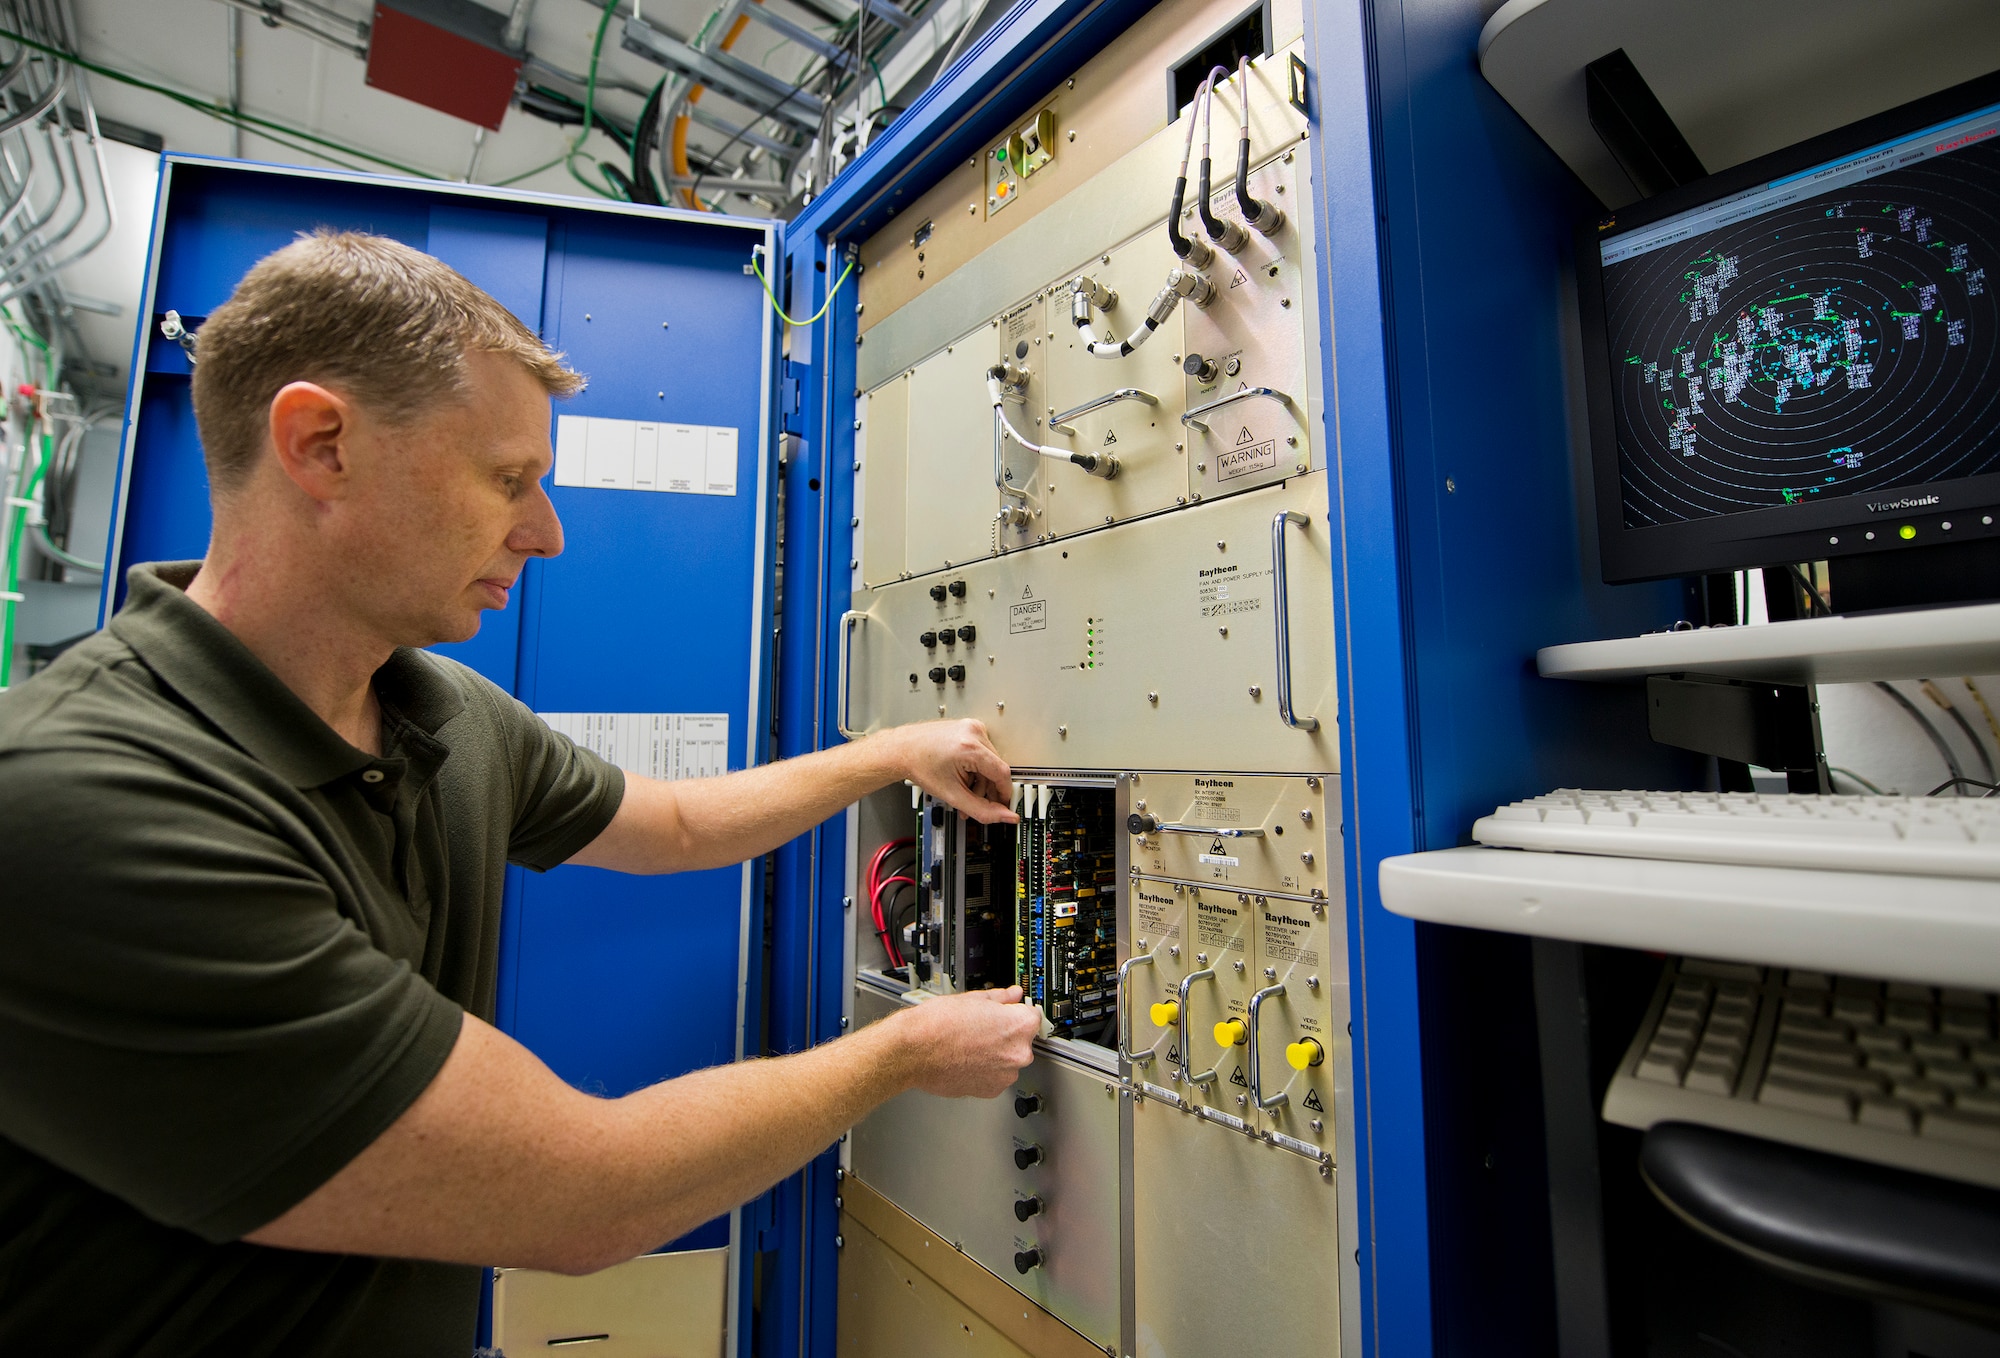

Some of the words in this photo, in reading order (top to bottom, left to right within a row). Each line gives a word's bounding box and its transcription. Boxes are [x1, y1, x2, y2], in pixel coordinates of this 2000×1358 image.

[1935, 128, 1997, 153] Raytheon
[1814, 170, 1834, 179] Radar
[1835, 164, 1852, 172] Data
[1853, 154, 1880, 166] Display
[1260, 256, 1287, 272] SENSITIVITY
[1008, 303, 1033, 319] Raytheon
[1201, 385, 1217, 394] MONITOR
[1221, 443, 1271, 468] WARNING
[1228, 466, 1246, 475] WEIGHT
[1866, 494, 1940, 513] ViewSonic
[1199, 565, 1238, 578] Raytheon
[1223, 574, 1241, 583] POWER
[1242, 571, 1262, 580] SUPPLY
[1013, 603, 1042, 616] DANGER
[1195, 779, 1233, 788] Raytheon
[1139, 892, 1174, 905] Raytheon
[1198, 902, 1238, 916] Raytheon
[1198, 913, 1217, 922] RECEIVER
[1265, 912, 1310, 928] Raytheon
[1265, 925, 1288, 934] RECEIVER
[1165, 988, 1179, 996] MONITO
[1228, 1005, 1247, 1014] MONITOR
[1303, 1016, 1318, 1025] VIDEO
[1300, 1023, 1322, 1033] MONITOR
